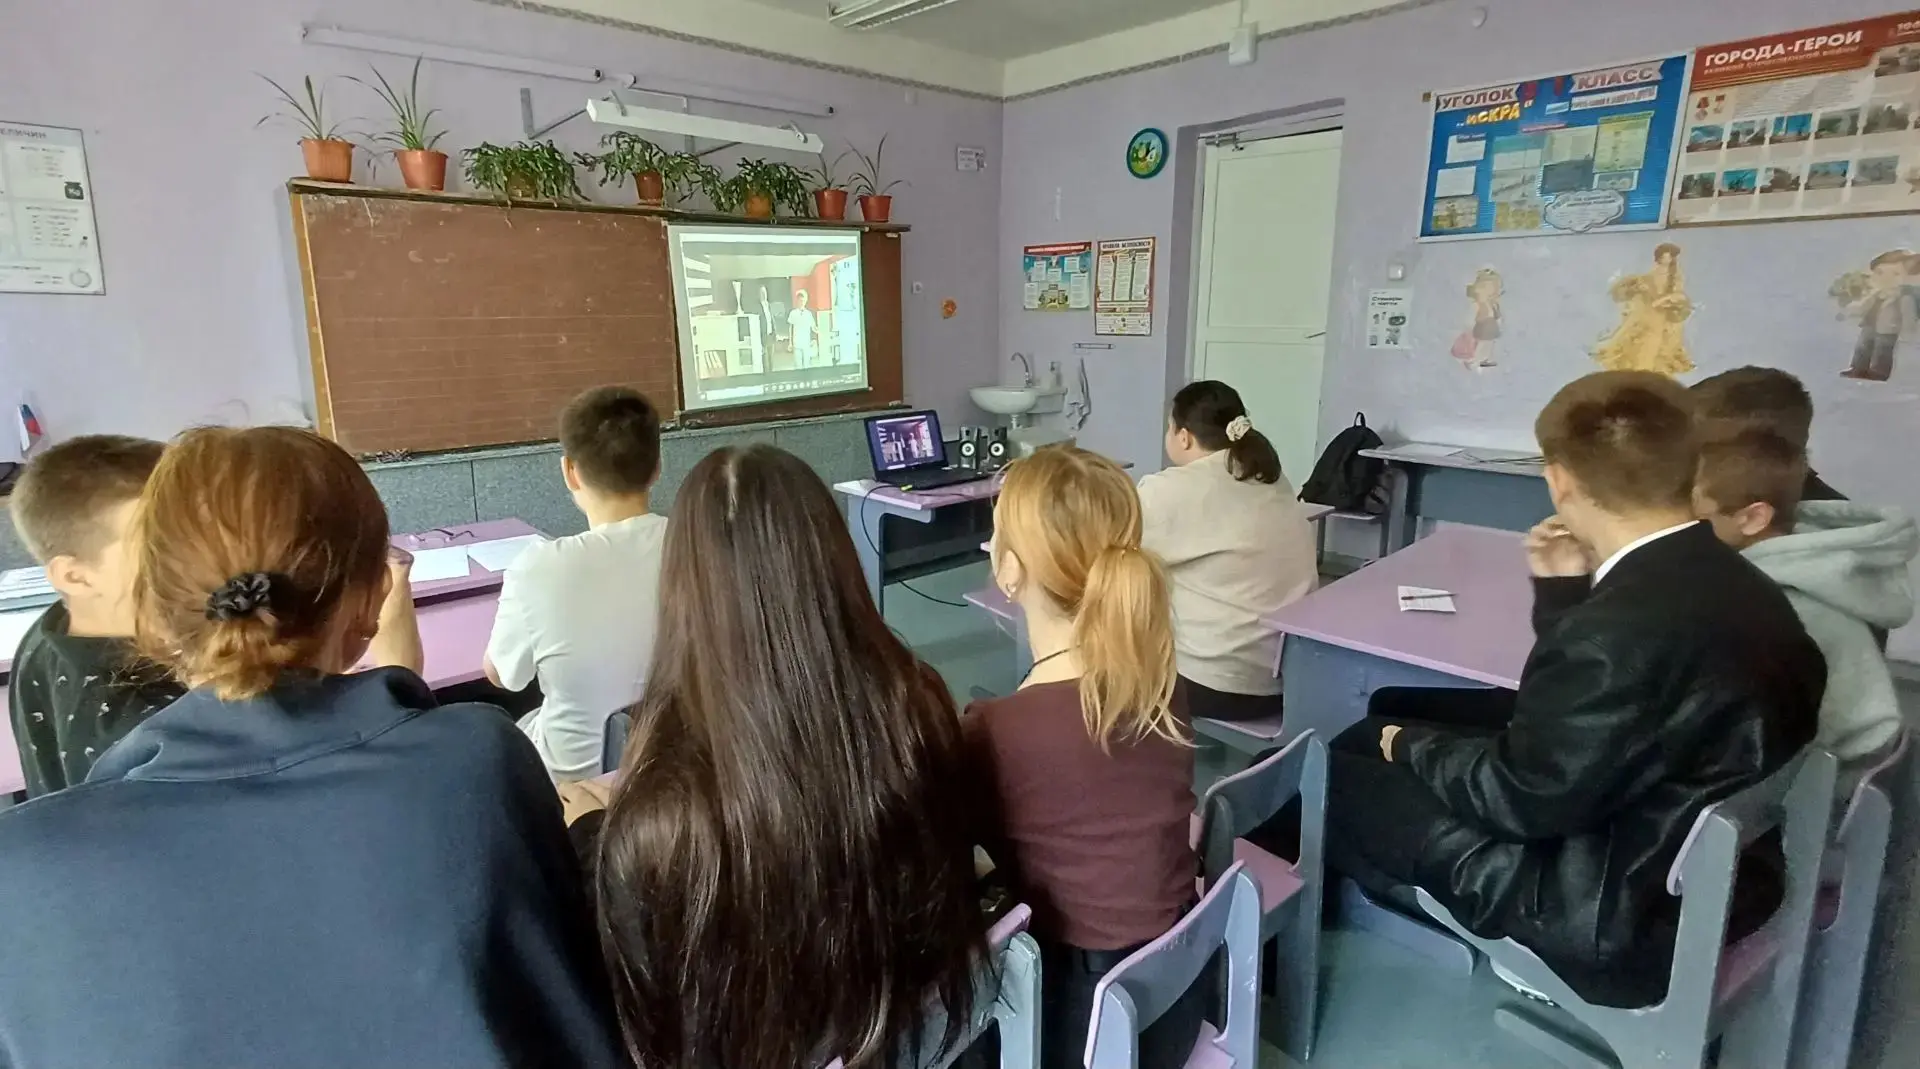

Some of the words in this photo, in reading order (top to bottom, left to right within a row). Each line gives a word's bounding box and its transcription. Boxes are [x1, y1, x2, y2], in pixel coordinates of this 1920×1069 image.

[1705, 30, 1863, 67] ГОРОДА-ГЕРОИ
[1442, 87, 1514, 110] УГОЛОК
[1577, 67, 1653, 90] КЛАСС
